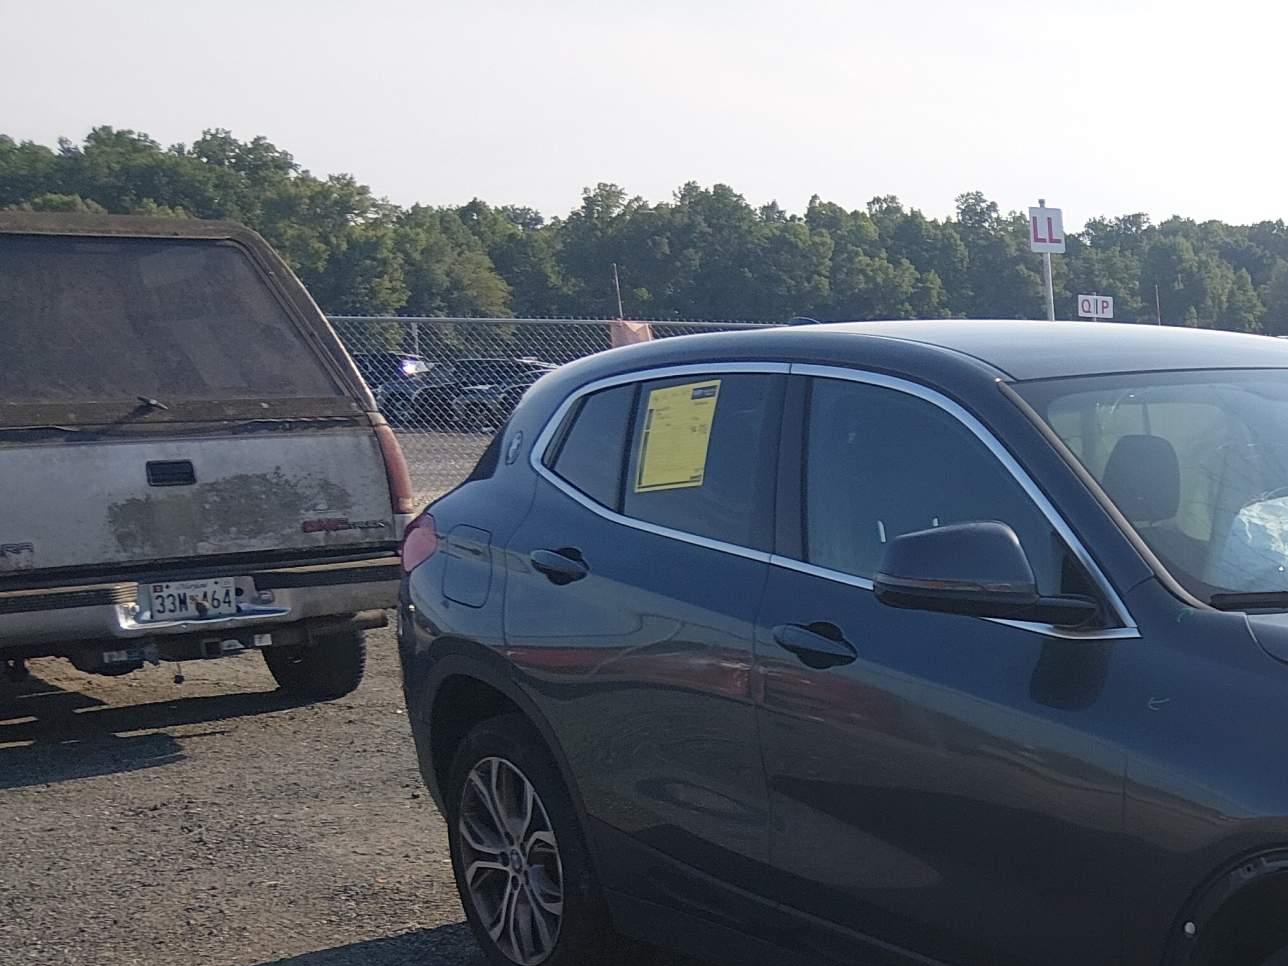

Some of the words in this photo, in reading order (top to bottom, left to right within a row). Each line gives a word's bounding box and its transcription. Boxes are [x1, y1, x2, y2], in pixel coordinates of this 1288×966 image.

[1032, 216, 1062, 243] LL
[1081, 299, 1091, 313] Q
[1101, 300, 1109, 314] P
